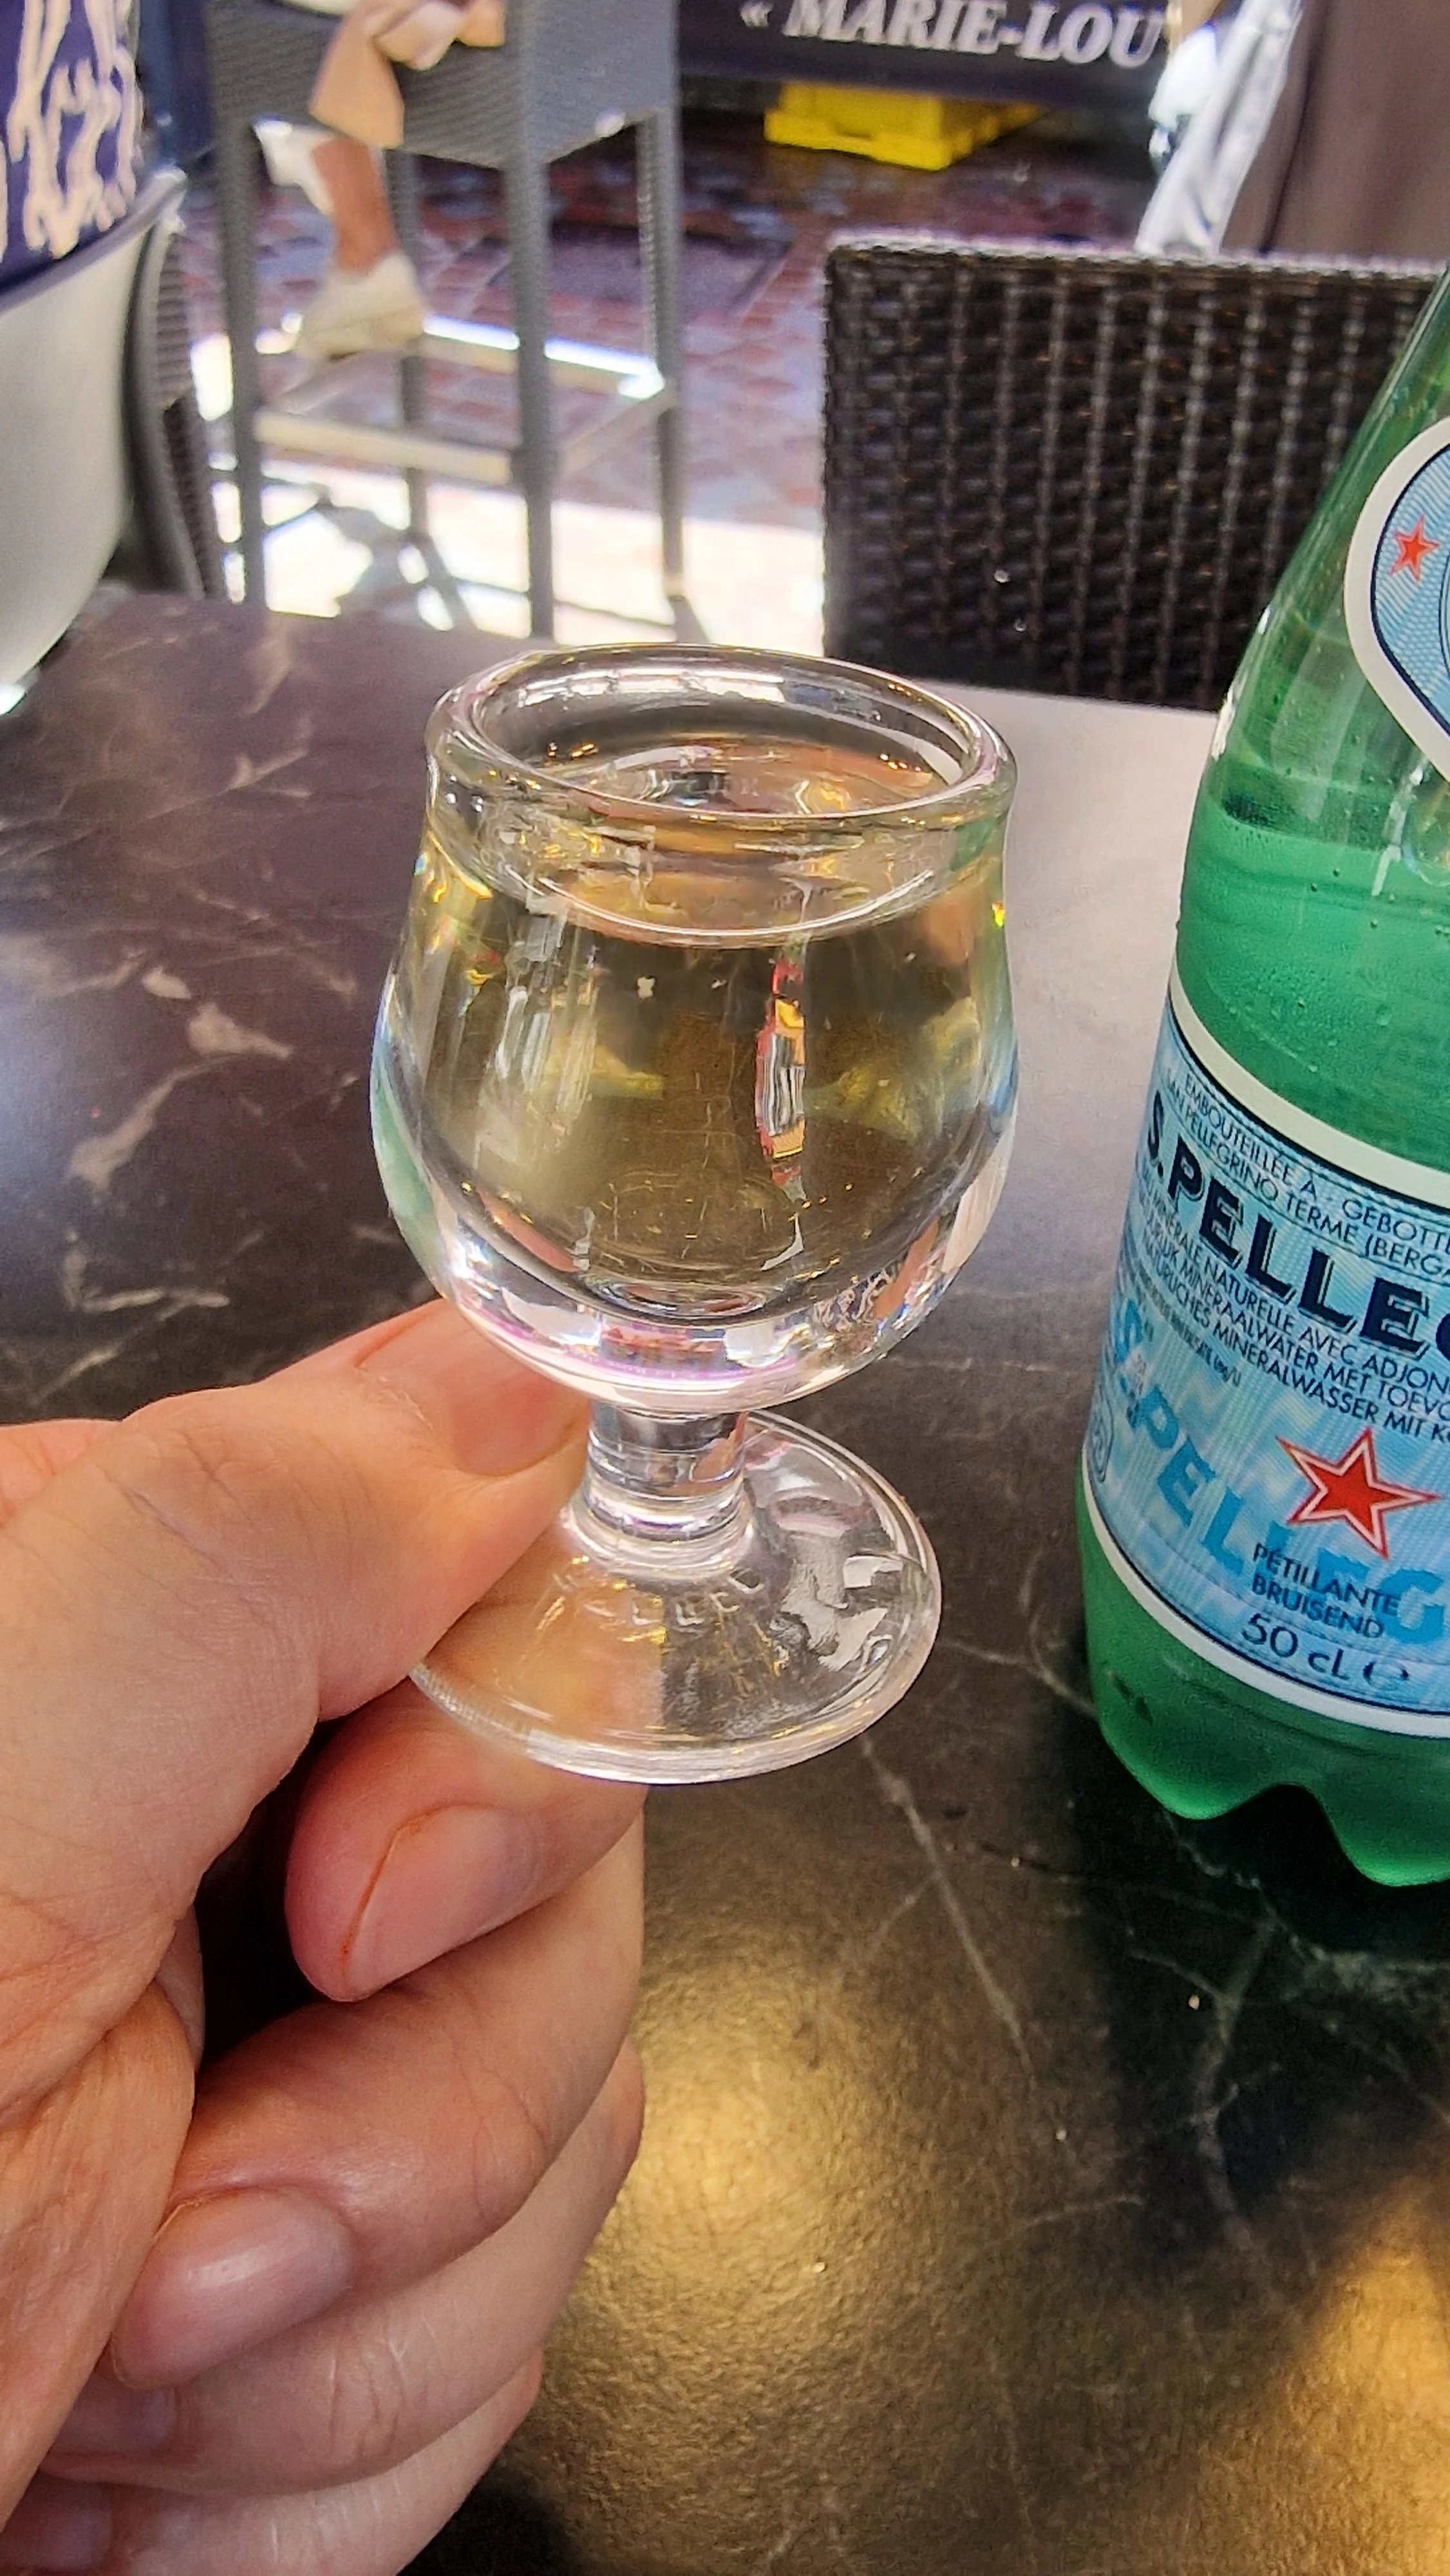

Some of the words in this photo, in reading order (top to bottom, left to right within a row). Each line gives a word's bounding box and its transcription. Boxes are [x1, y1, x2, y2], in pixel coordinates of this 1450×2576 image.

[1147, 1088, 1450, 1362] S.PELLE
[1287, 1191, 1359, 1245] TERME
[1364, 1233, 1450, 1278] (BERG
[1342, 1198, 1450, 1255] GEBOTT
[1299, 1325, 1357, 1365] AVEC
[1323, 1361, 1371, 1395] MET
[1383, 1410, 1424, 1437] MIT
[1431, 1422, 1450, 1443] K
[1252, 1572, 1384, 1639] BRUISEND
[1241, 1613, 1299, 1659] 50
